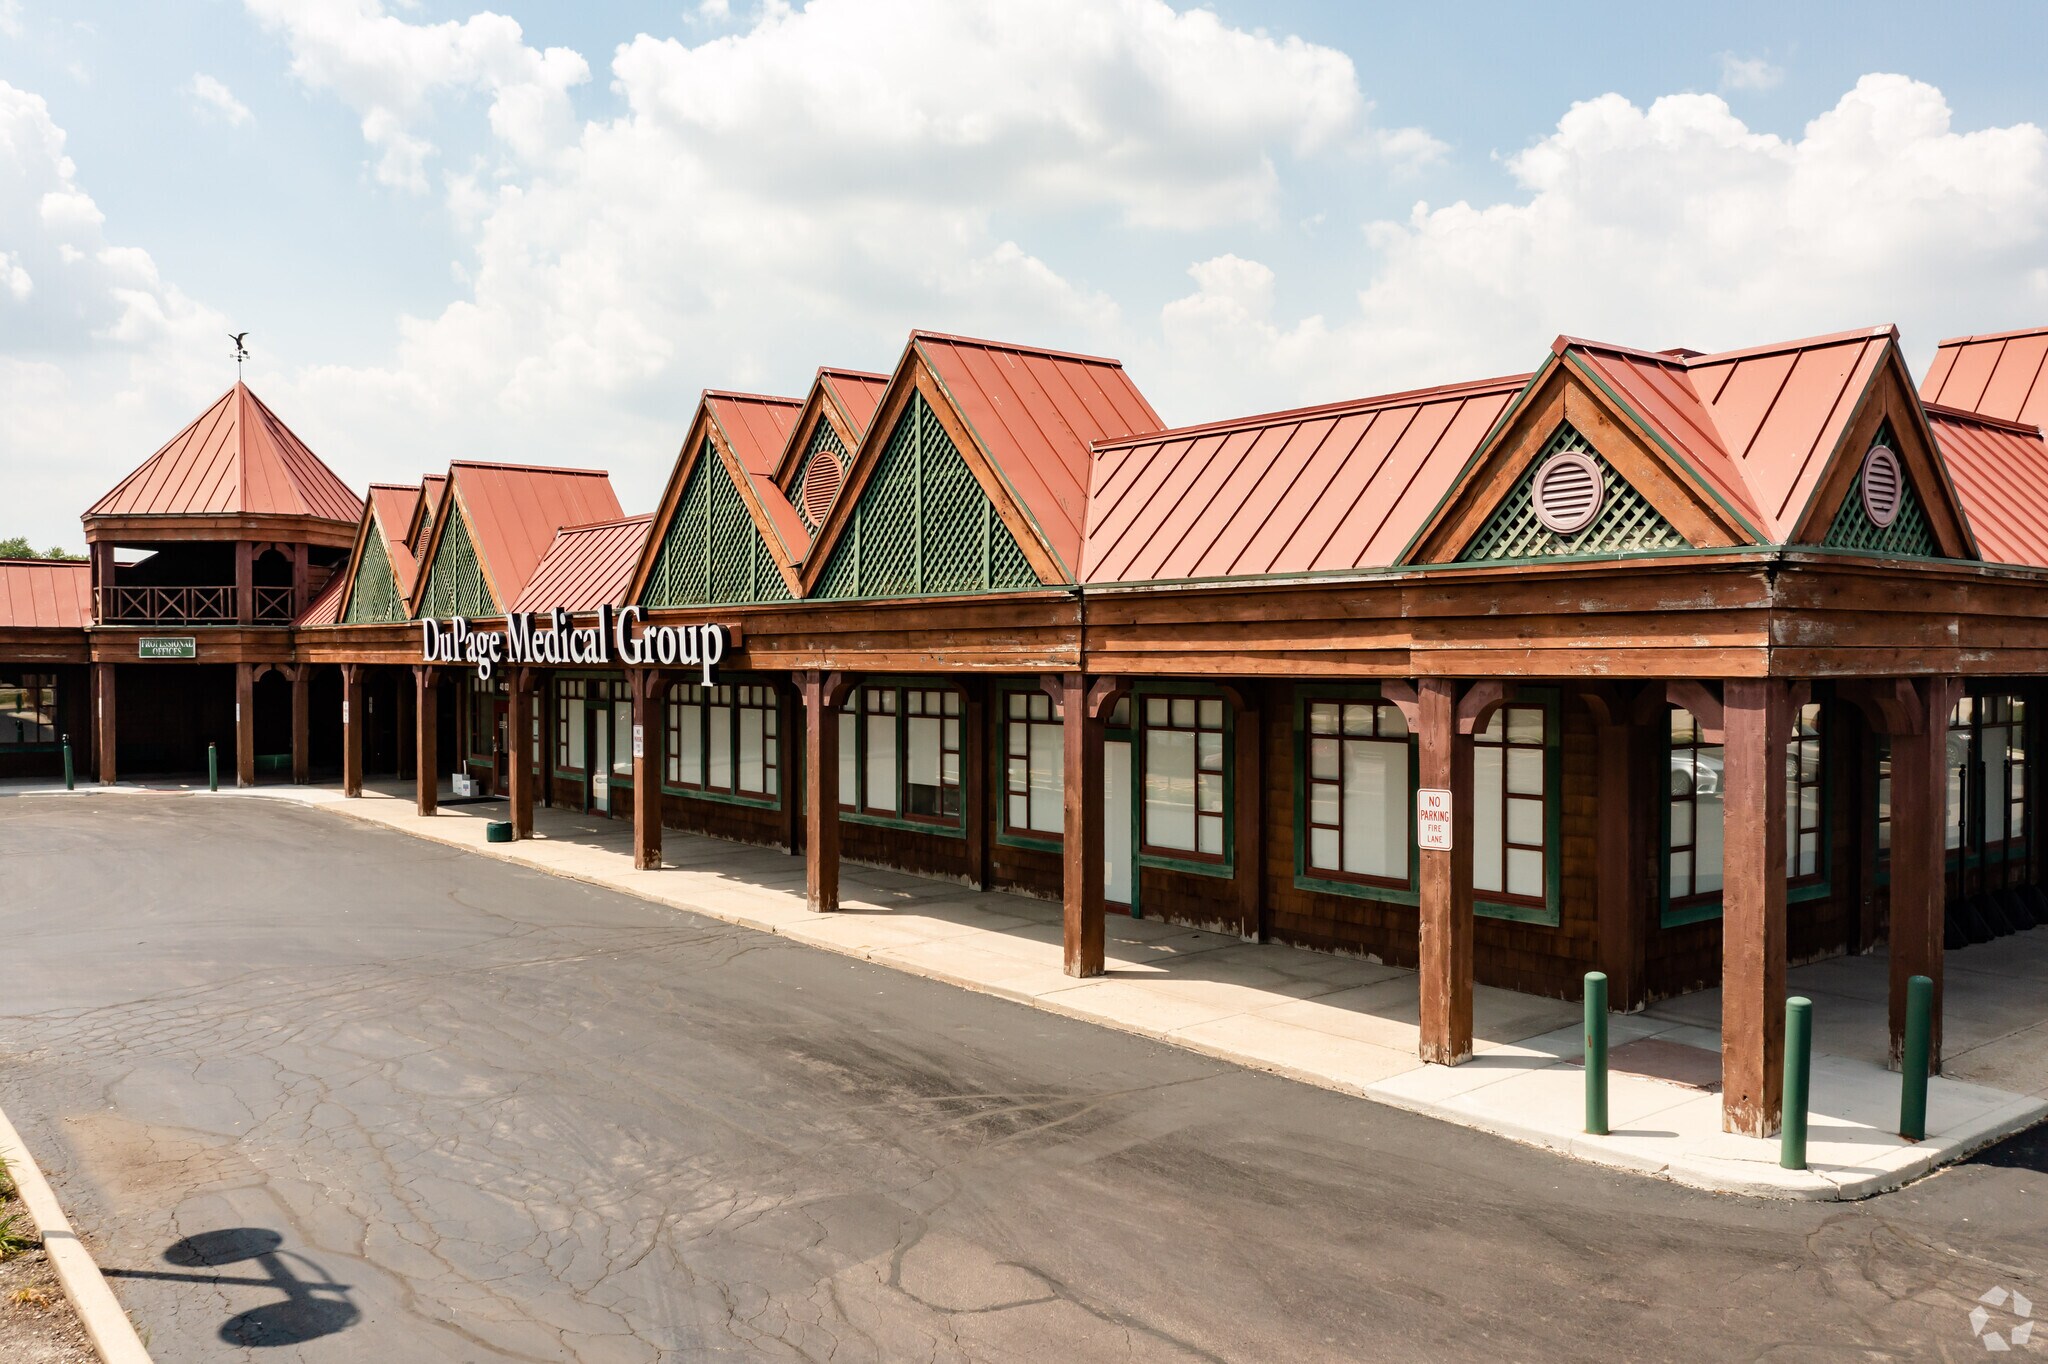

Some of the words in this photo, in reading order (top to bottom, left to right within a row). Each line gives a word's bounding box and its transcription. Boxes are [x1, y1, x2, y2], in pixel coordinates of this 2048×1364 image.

[422, 617, 501, 680] DuPage
[506, 604, 608, 664] Medical
[616, 605, 723, 687] Group
[152, 647, 182, 655] OFFICES
[1429, 796, 1441, 807] NO
[1421, 810, 1449, 822] PARKING
[1428, 824, 1442, 832] FIRE
[1428, 835, 1443, 843] LANE
